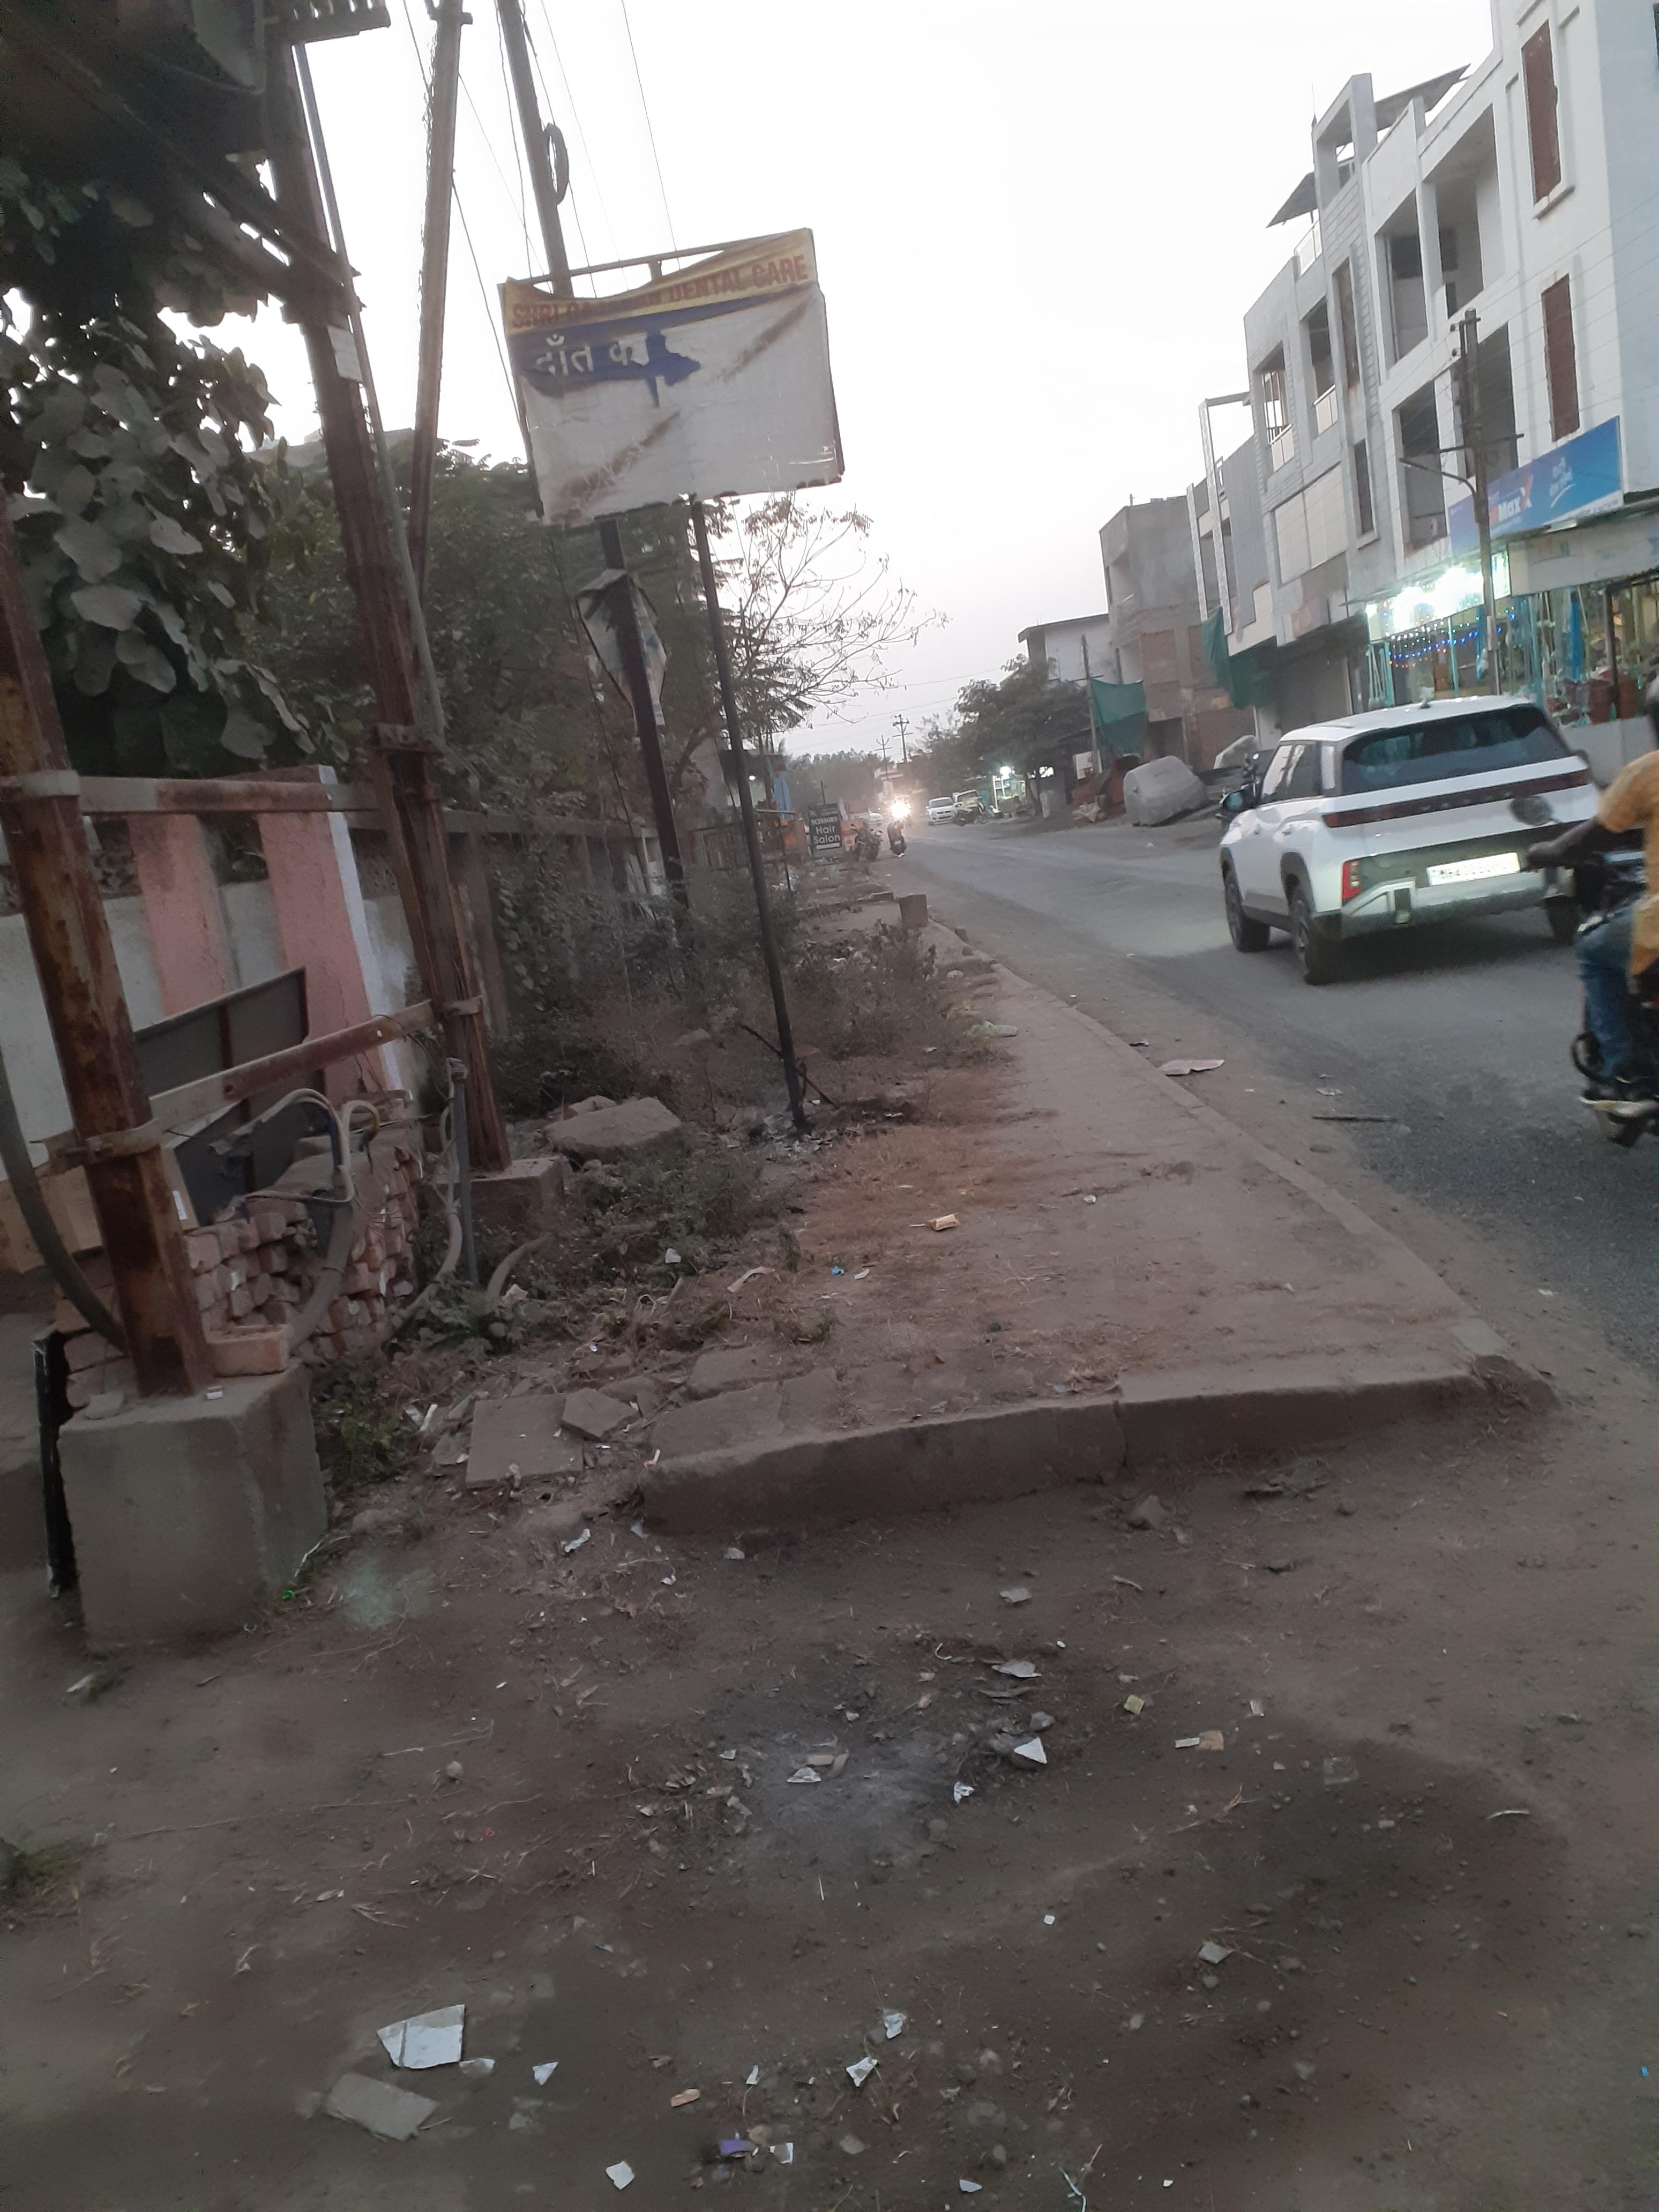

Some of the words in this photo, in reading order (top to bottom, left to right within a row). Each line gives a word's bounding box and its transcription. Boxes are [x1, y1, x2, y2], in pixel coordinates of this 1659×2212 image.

[751, 255, 809, 288] CARE
[816, 825, 835, 835] Hair
[813, 835, 841, 845] Salon
